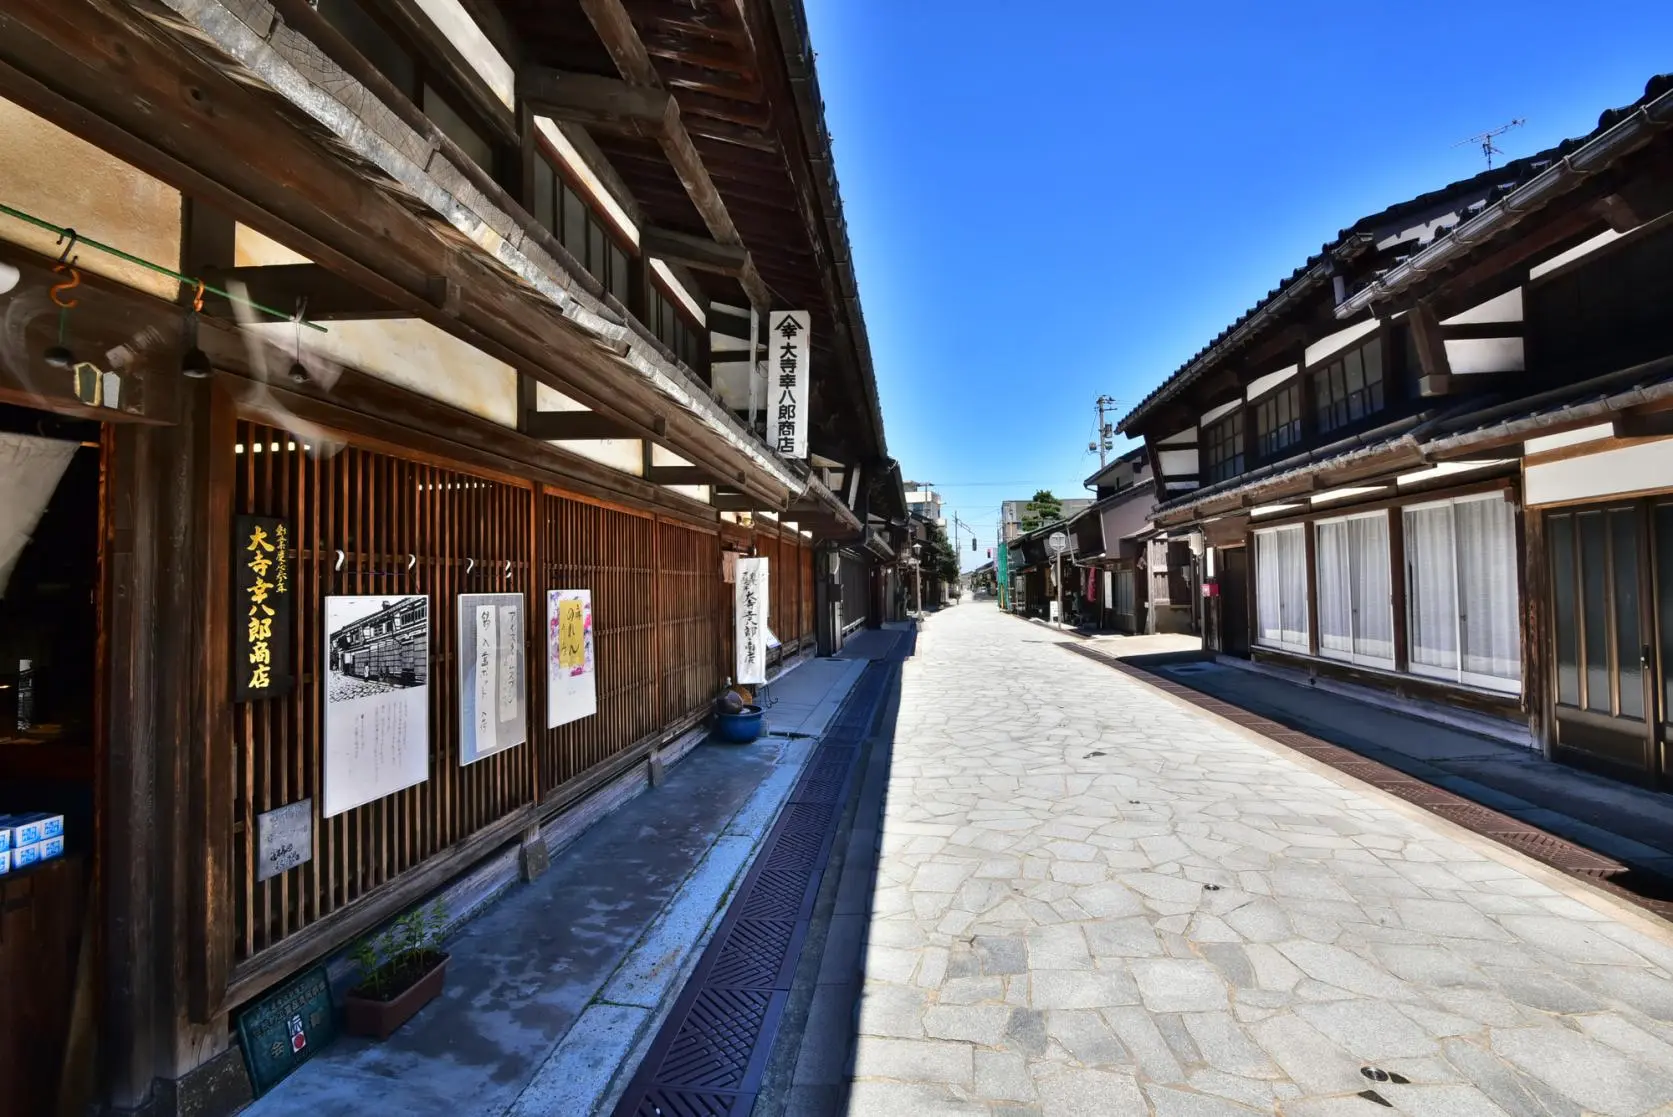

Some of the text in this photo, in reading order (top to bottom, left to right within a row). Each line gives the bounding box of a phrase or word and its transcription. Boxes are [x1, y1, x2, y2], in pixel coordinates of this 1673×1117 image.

[781, 323, 797, 340] 幸
[776, 342, 797, 453] 大寺幸八郎商店
[246, 525, 275, 689] 大寺幸八郎商店
